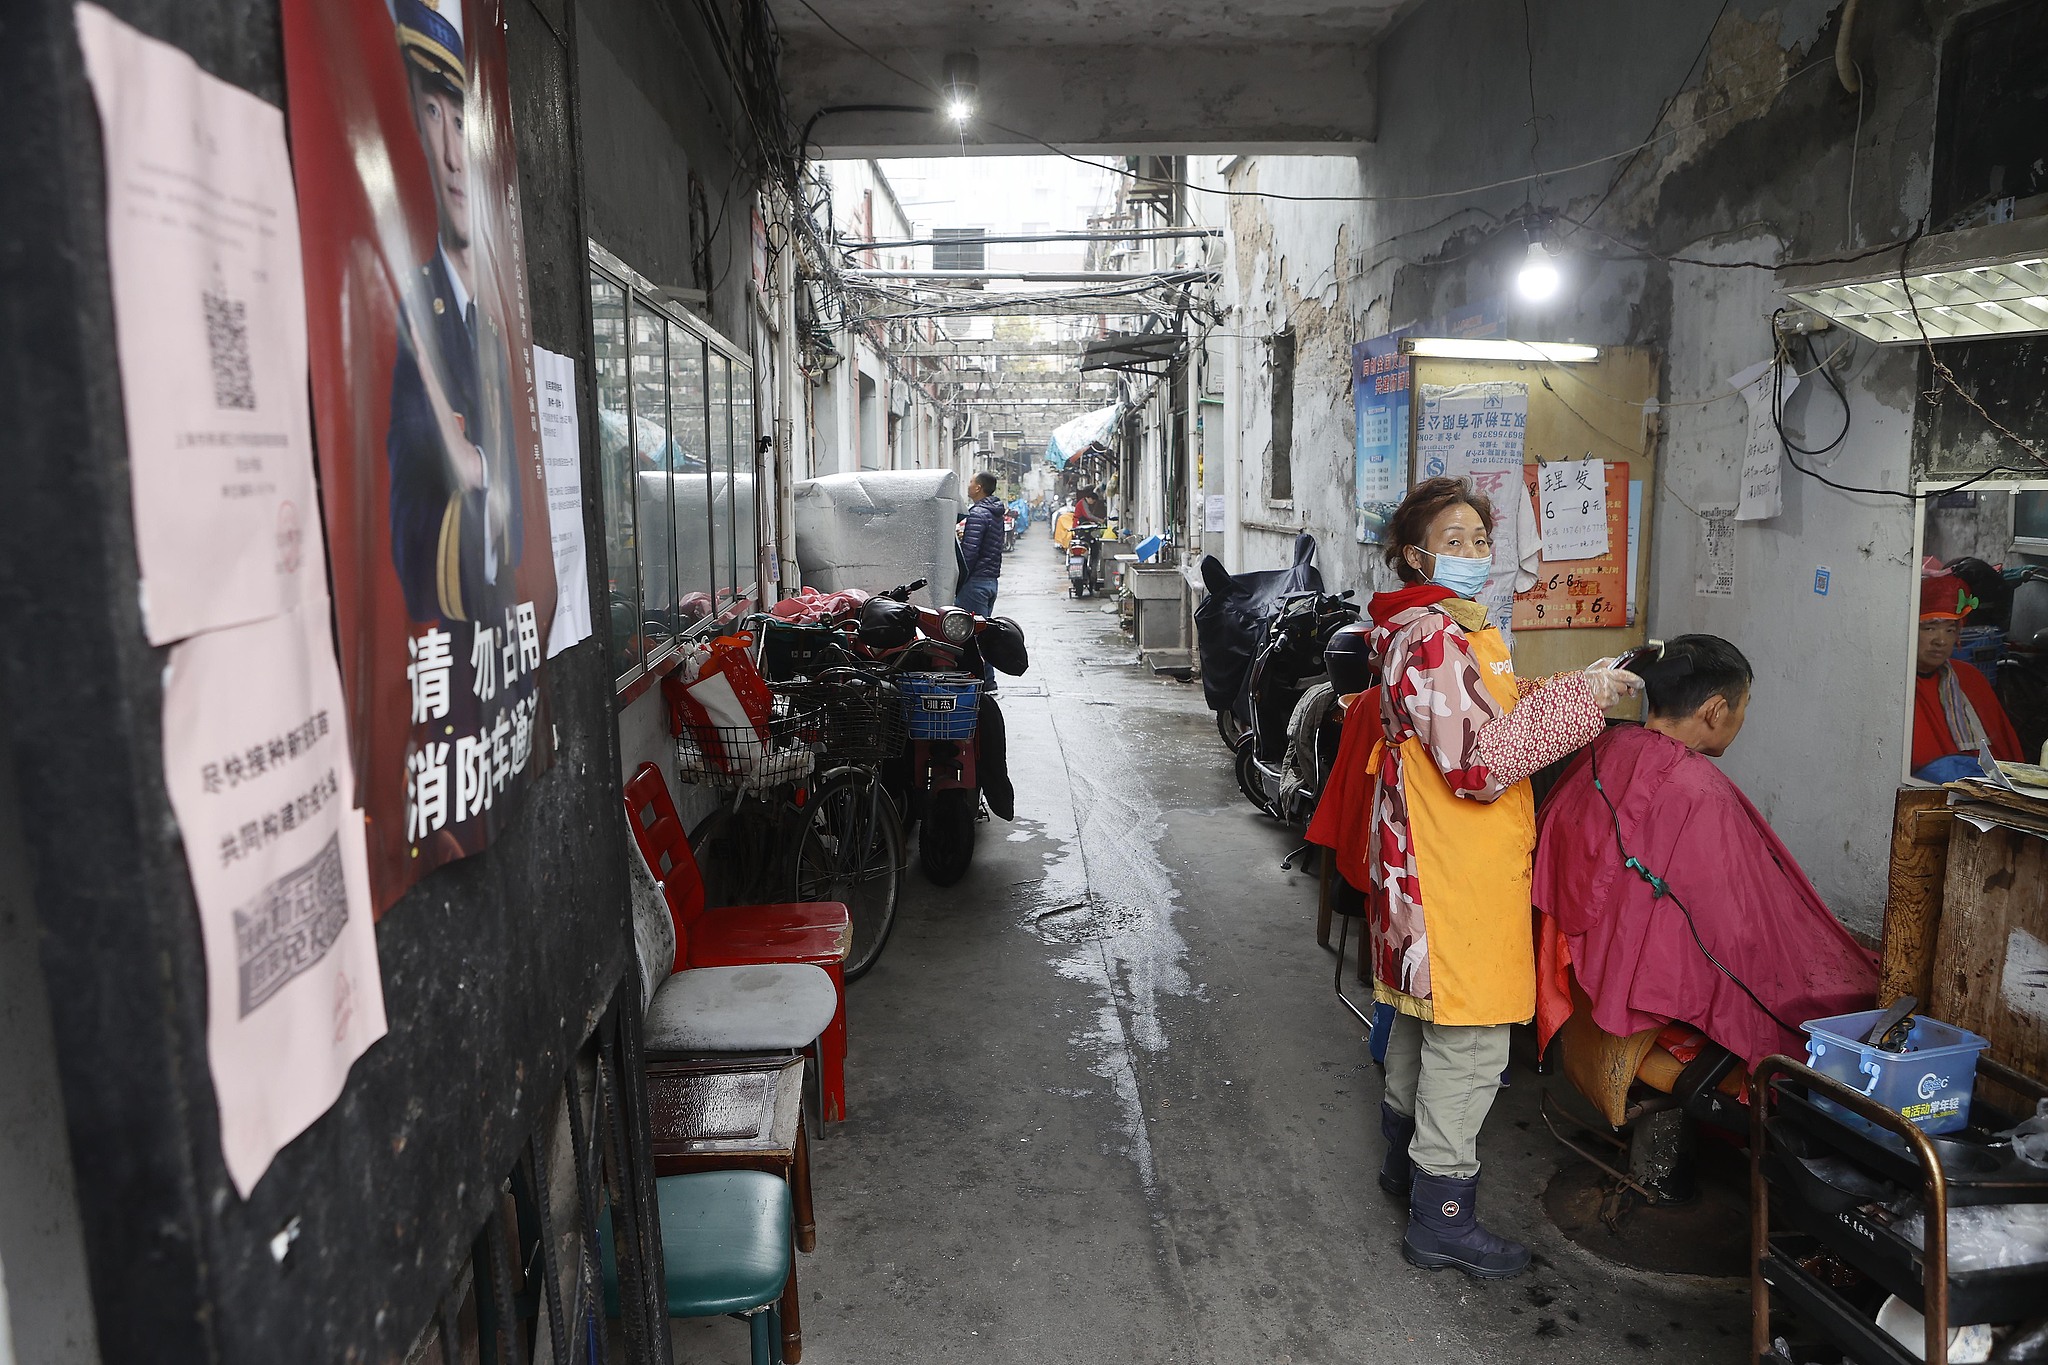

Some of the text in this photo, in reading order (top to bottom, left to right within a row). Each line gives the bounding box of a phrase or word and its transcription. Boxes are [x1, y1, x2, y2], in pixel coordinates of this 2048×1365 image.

[1417, 411, 1527, 431] 双五粉业有限公司
[1544, 469, 1592, 491] 理发
[1570, 566, 1618, 575] 无痛穿耳元/对
[1493, 592, 1513, 602] GWU
[407, 601, 541, 725] 请勿占用
